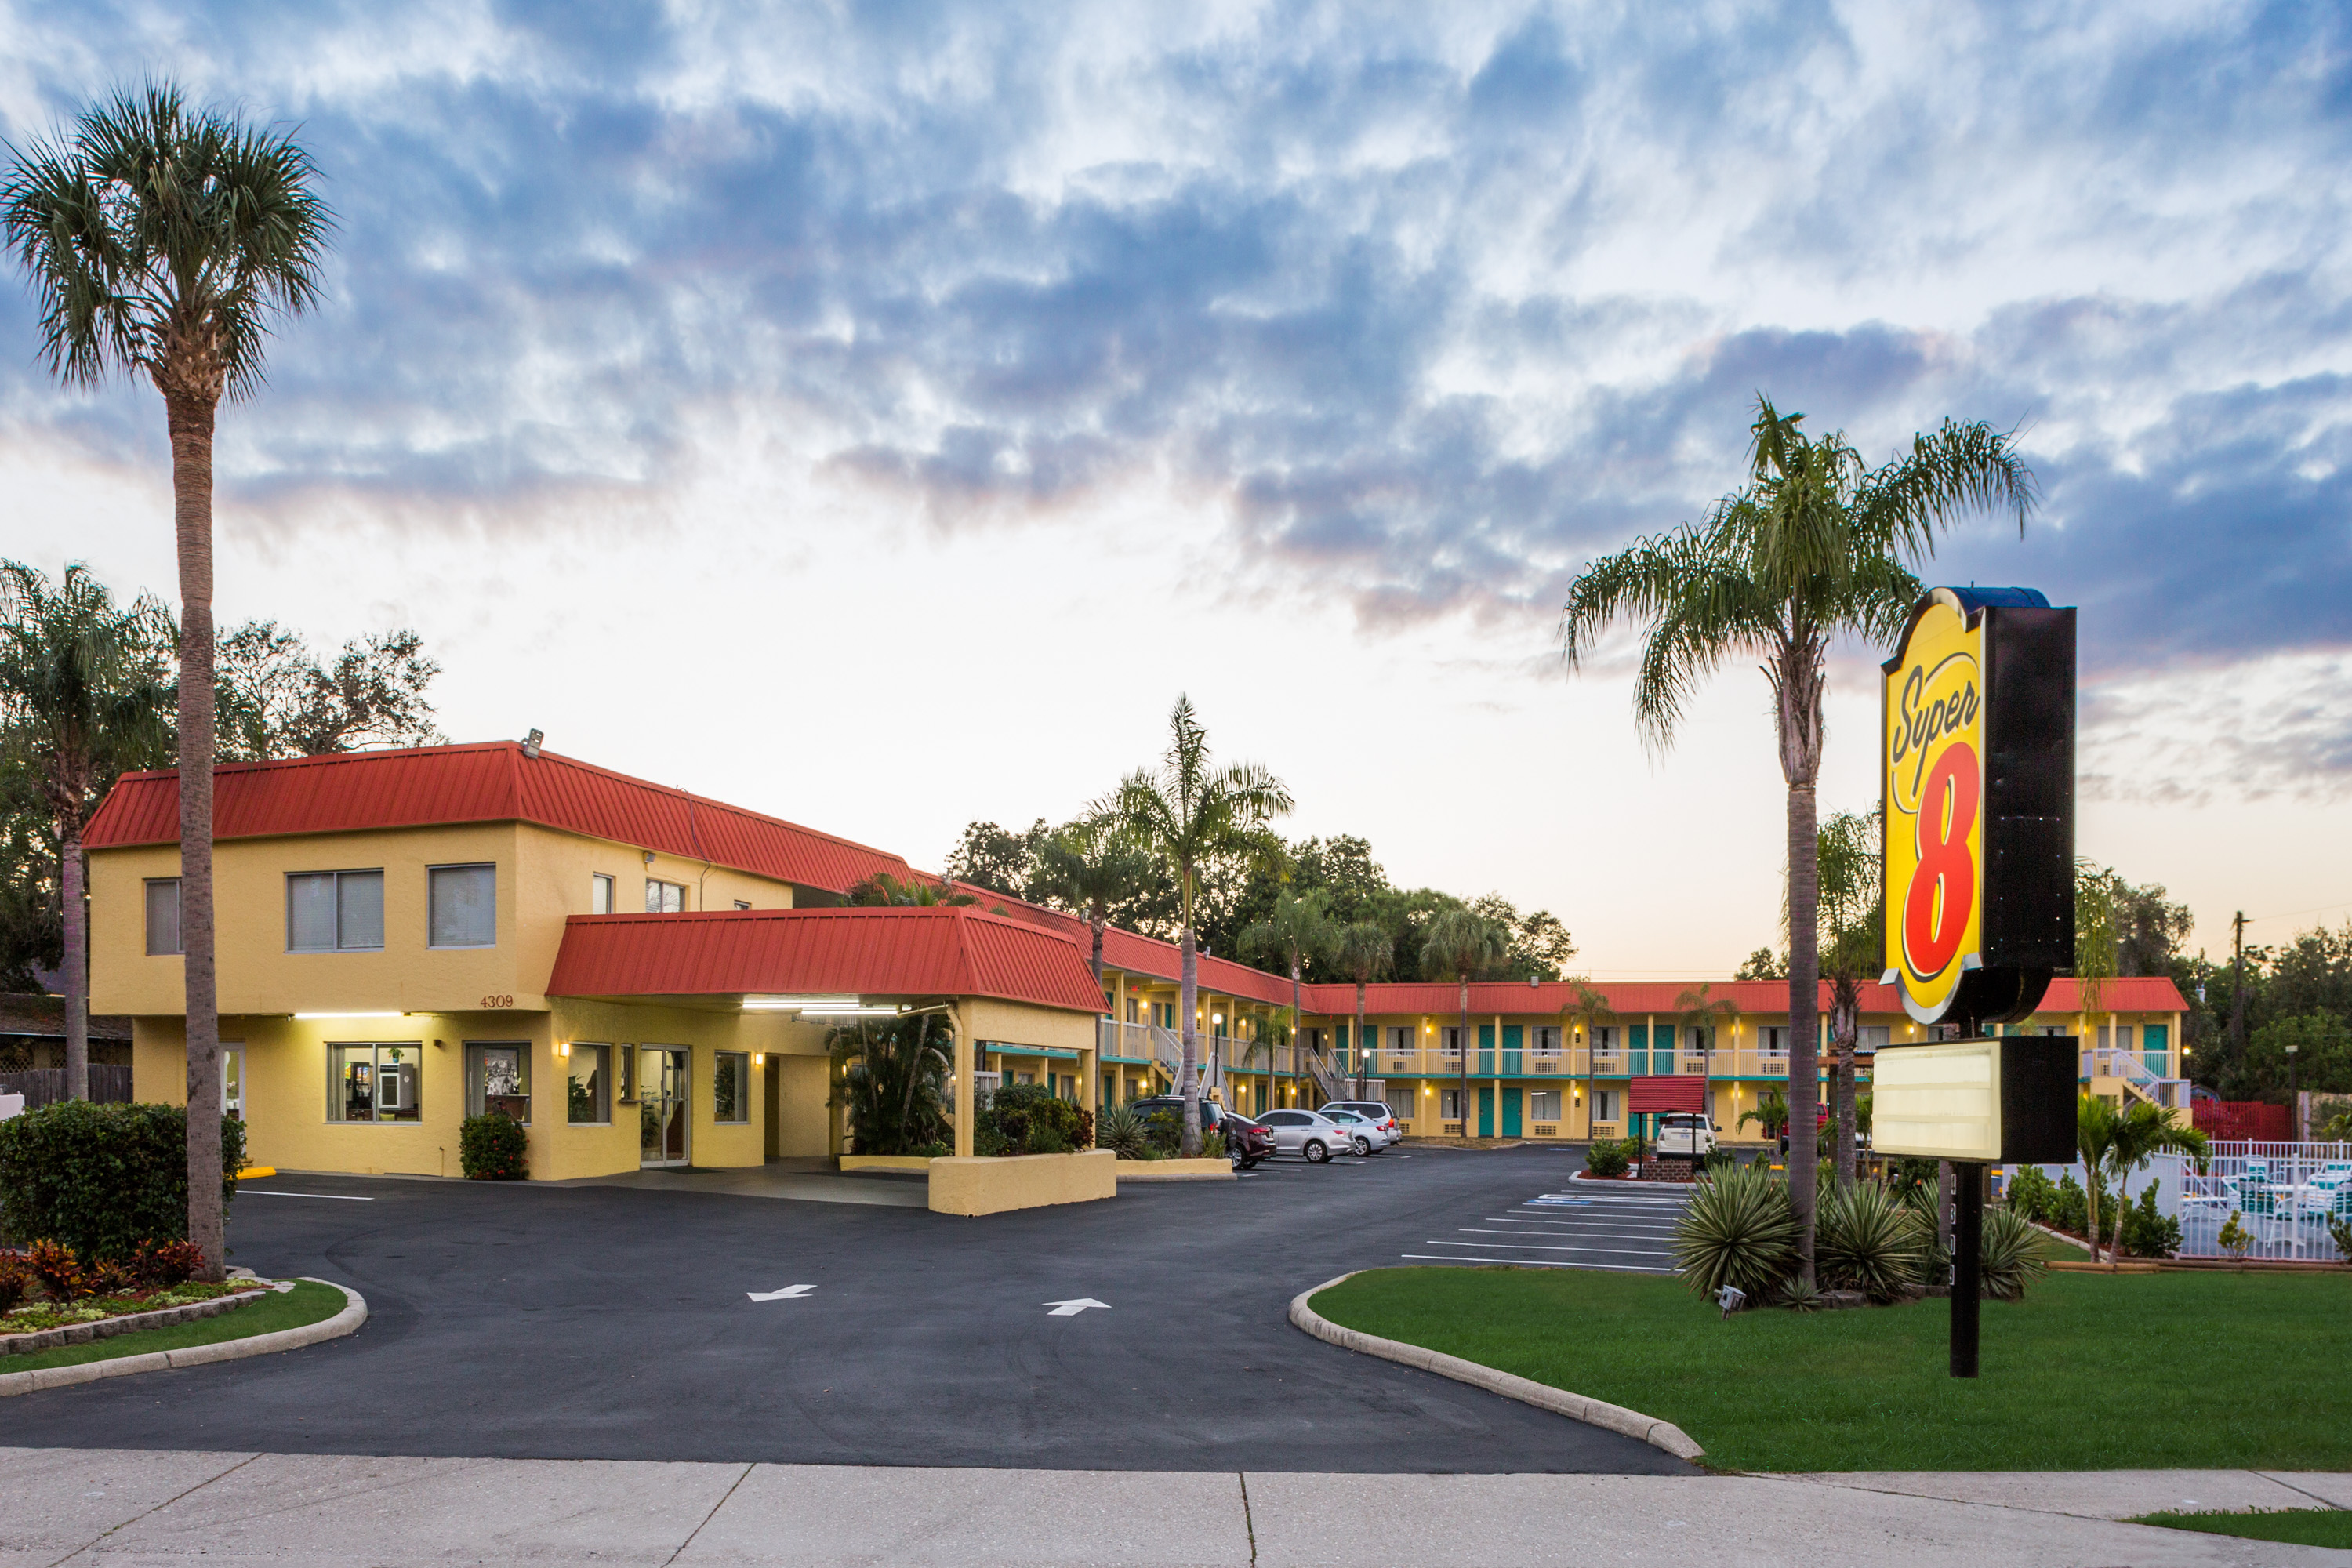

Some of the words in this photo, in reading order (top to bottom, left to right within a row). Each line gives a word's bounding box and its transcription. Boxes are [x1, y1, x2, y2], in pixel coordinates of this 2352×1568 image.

[1891, 665, 1980, 799] Super
[1902, 742, 1980, 982] 8
[481, 995, 514, 1008] 4309
